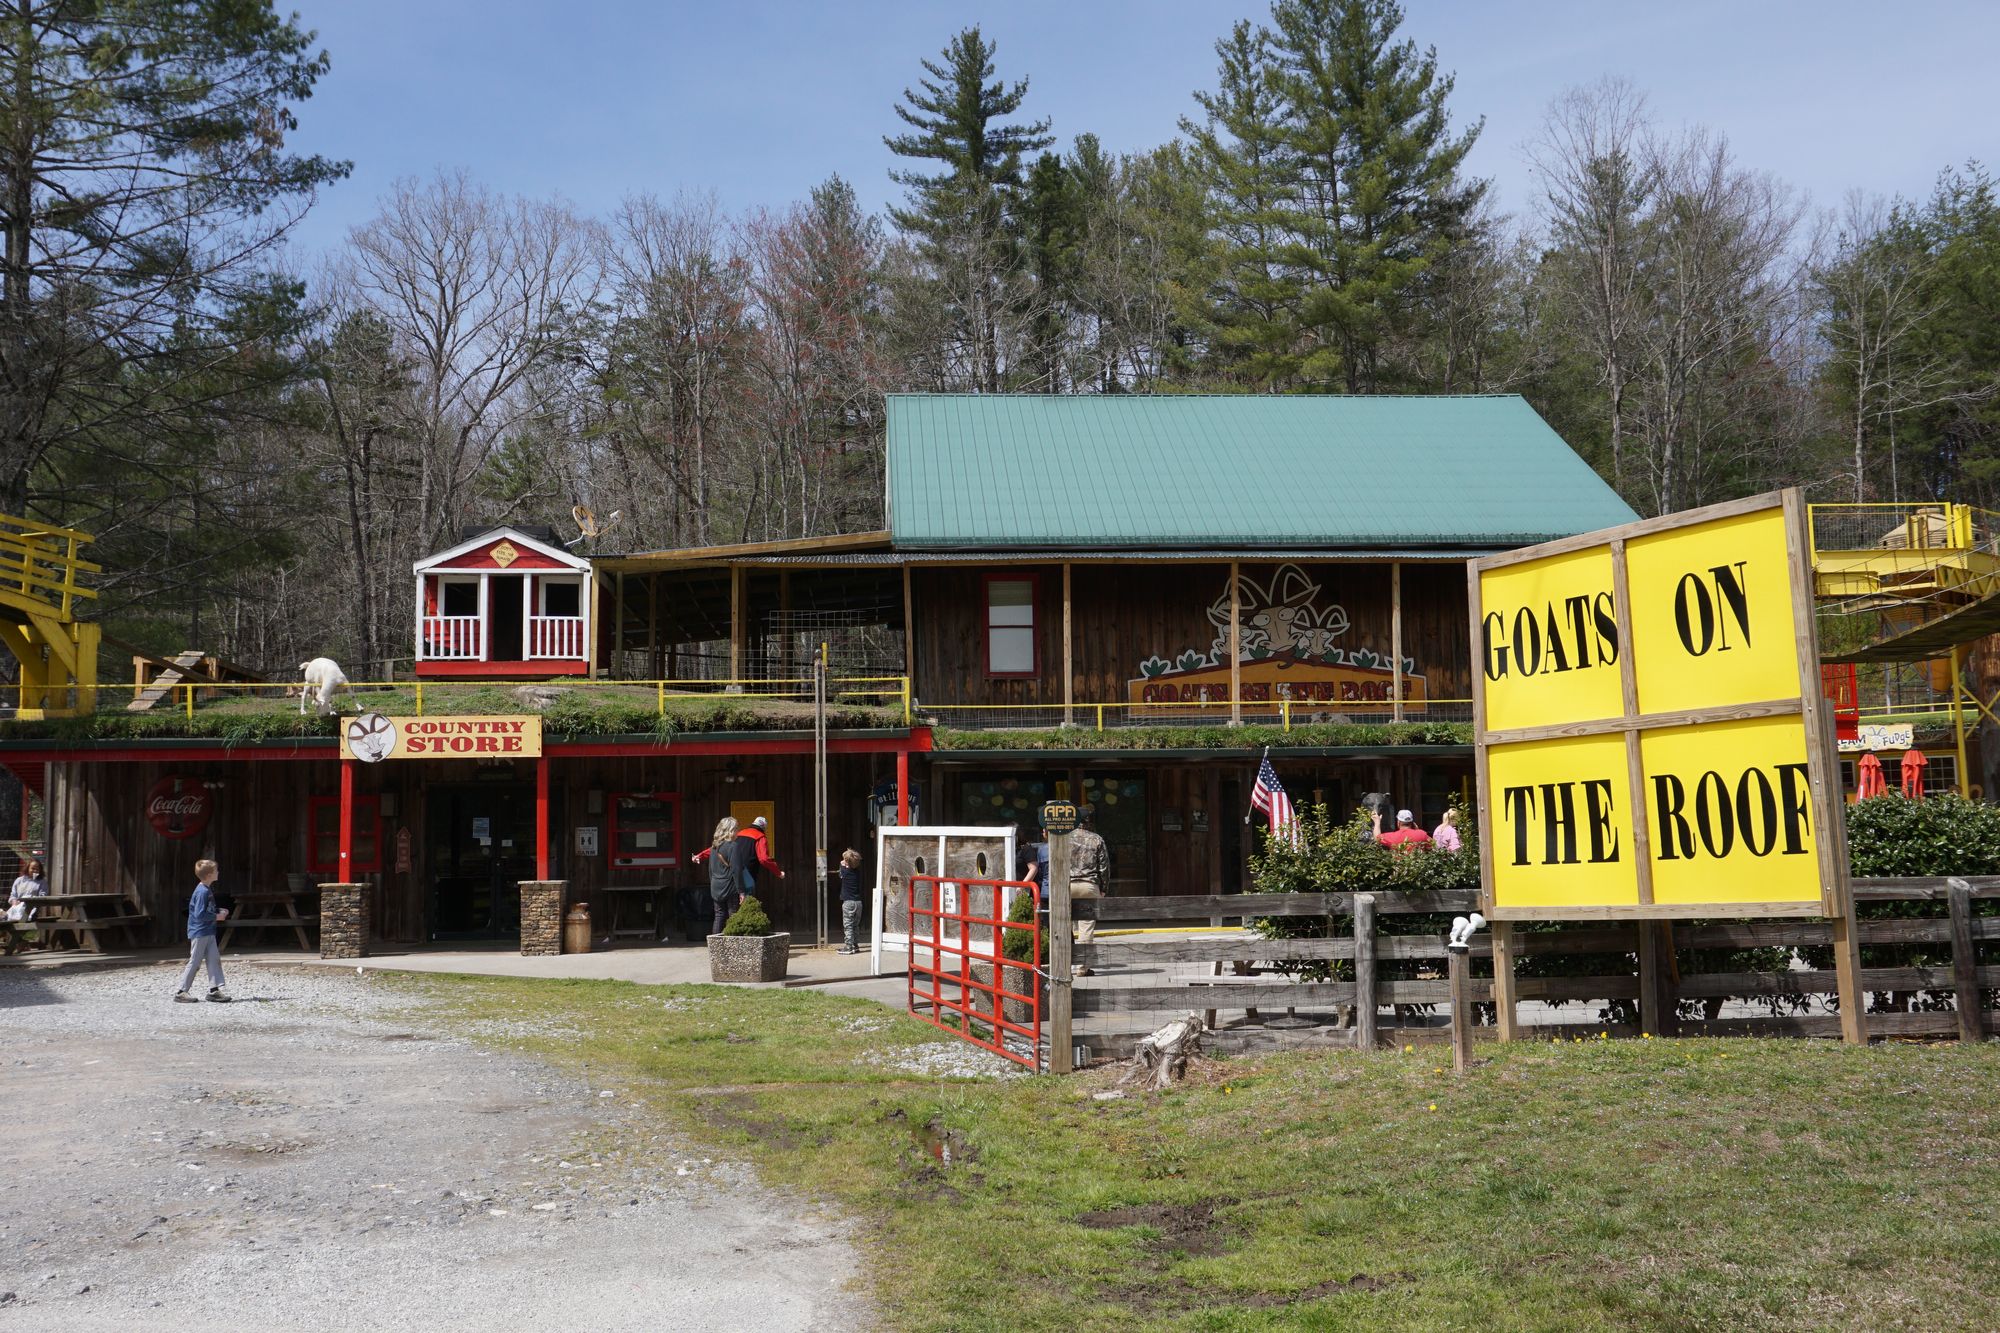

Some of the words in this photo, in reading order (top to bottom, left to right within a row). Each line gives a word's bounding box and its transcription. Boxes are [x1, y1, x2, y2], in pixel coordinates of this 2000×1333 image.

[1483, 590, 1620, 681] GOATS
[1674, 561, 1751, 657] ON
[404, 721, 526, 734] COUNTRY
[406, 736, 523, 753] STORE
[1044, 805, 1076, 817] APA
[1503, 779, 1620, 866] THE
[1650, 763, 1813, 860] ROOF
